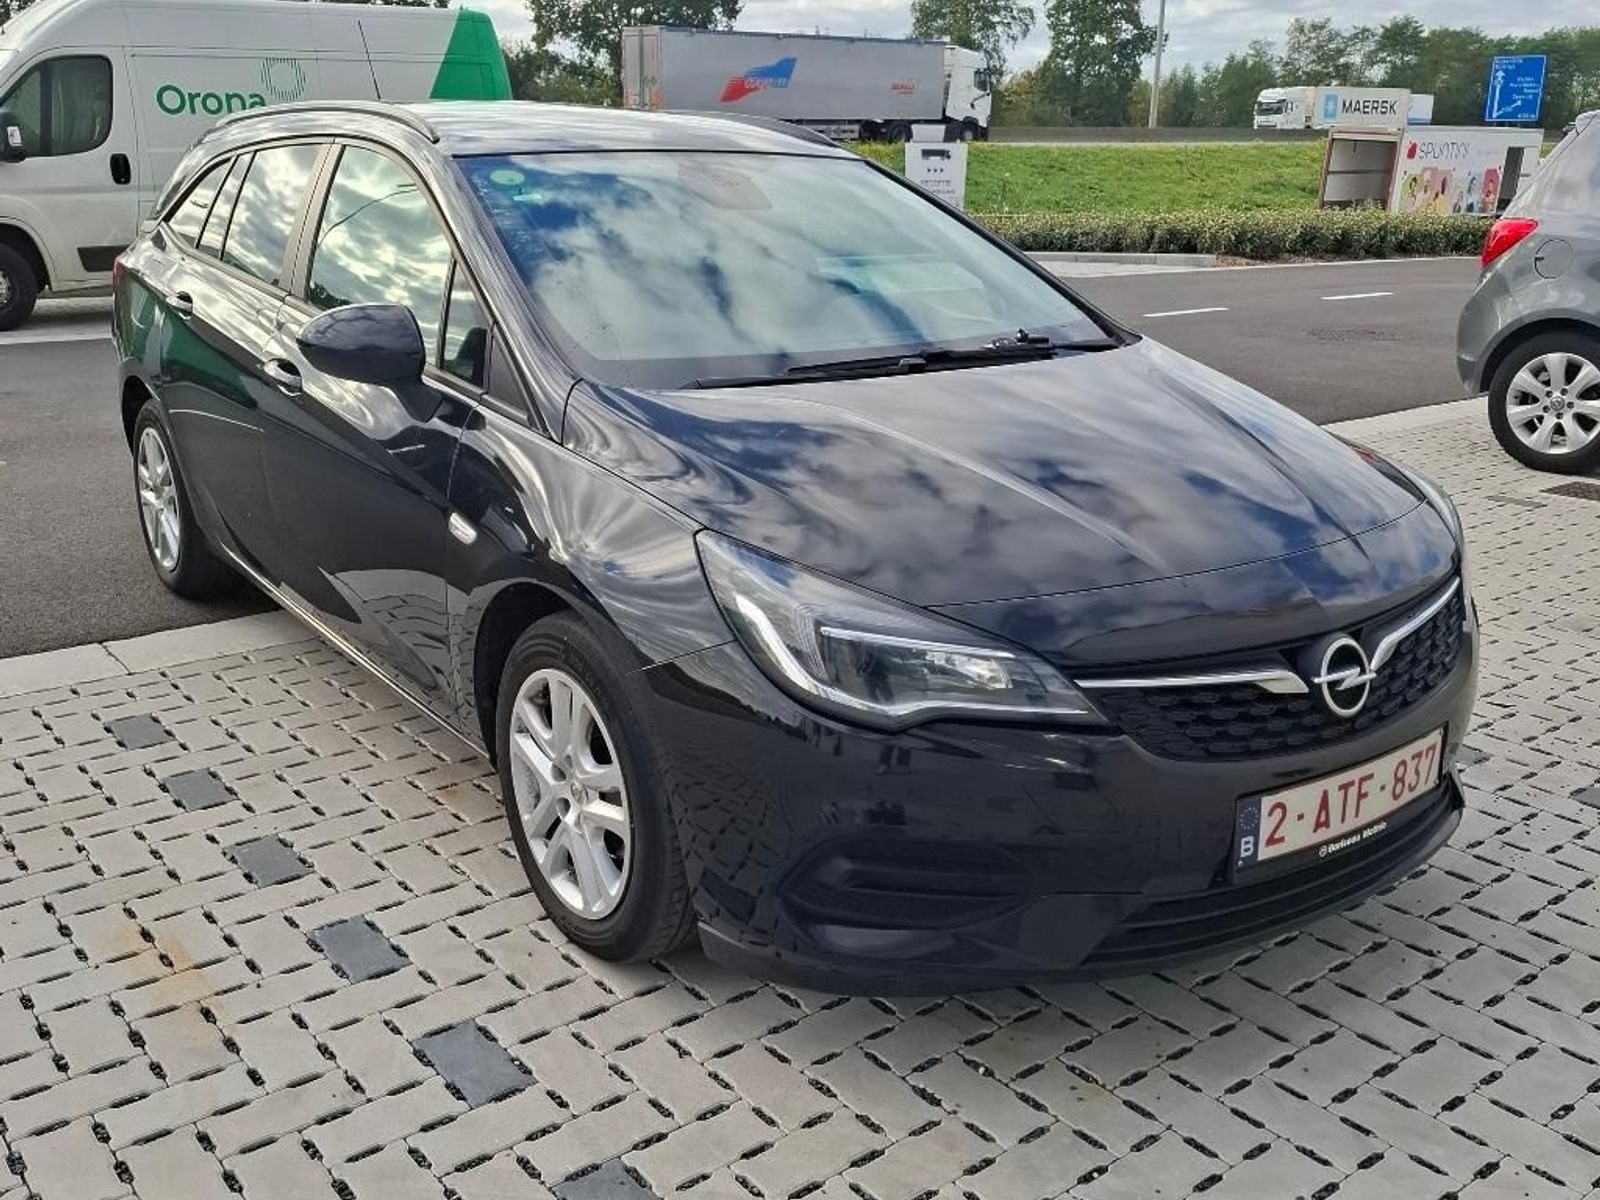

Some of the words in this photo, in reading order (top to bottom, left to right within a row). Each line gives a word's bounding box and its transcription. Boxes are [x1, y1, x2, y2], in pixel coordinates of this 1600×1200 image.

[156, 84, 266, 115] Orona
[1341, 100, 1398, 115] MAERSK
[1240, 835, 1254, 857] B
